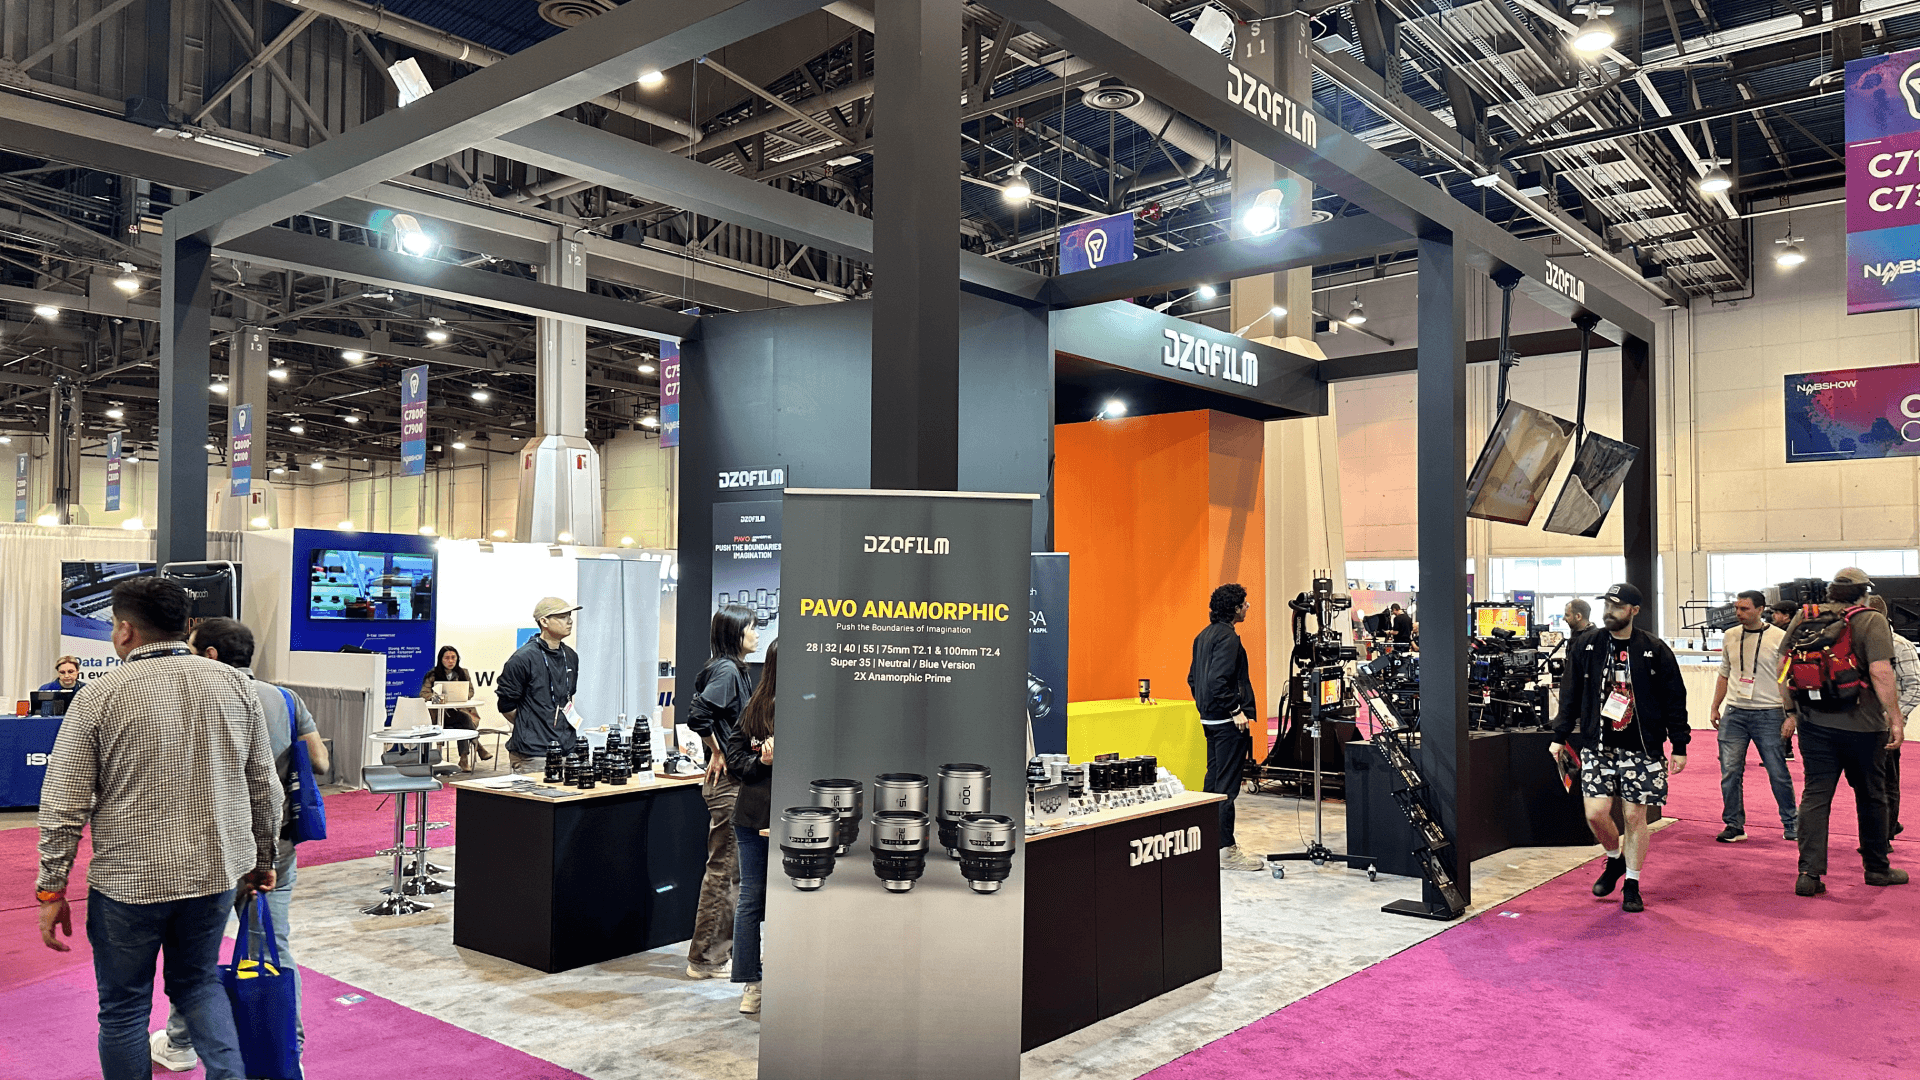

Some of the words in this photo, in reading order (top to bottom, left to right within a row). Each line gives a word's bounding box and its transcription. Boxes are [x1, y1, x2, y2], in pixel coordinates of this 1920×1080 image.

[1251, 22, 1260, 36] S
[1300, 22, 1306, 37] S
[1246, 39, 1265, 58] 11
[1227, 63, 1317, 149] DZOFILM
[570, 243, 577, 252] S
[567, 254, 582, 266] 12
[1545, 259, 1585, 304] DZOFILM
[251, 342, 262, 351] 13
[1163, 328, 1258, 387] DZOFILM
[404, 423, 423, 435] C7900
[719, 468, 784, 488] DZOFILM
[864, 536, 950, 555] DZOFILM
[801, 598, 857, 617] PAVO
[862, 600, 1010, 622] ANAMORPHIC
[836, 623, 856, 631] Push
[872, 624, 915, 632] Boundaries
[916, 625, 925, 633] of
[926, 625, 972, 635] Imagination
[806, 643, 819, 652] 28
[824, 643, 837, 653] 32
[843, 644, 856, 653] 40
[862, 644, 875, 654] 55
[881, 645, 911, 654] 75mm
[912, 645, 932, 655] T2.1
[934, 646, 942, 655] &
[944, 647, 978, 656] 100mm
[980, 647, 1001, 657] T2.4
[830, 657, 857, 668] Super
[859, 658, 871, 667] 35
[878, 659, 911, 668] Neutral
[919, 660, 940, 669] Blue
[941, 660, 976, 670] Version
[854, 672, 867, 681] 2X
[868, 672, 923, 684] Anamorphic
[924, 674, 952, 683] Prime
[1130, 826, 1201, 867] DZOFILM
